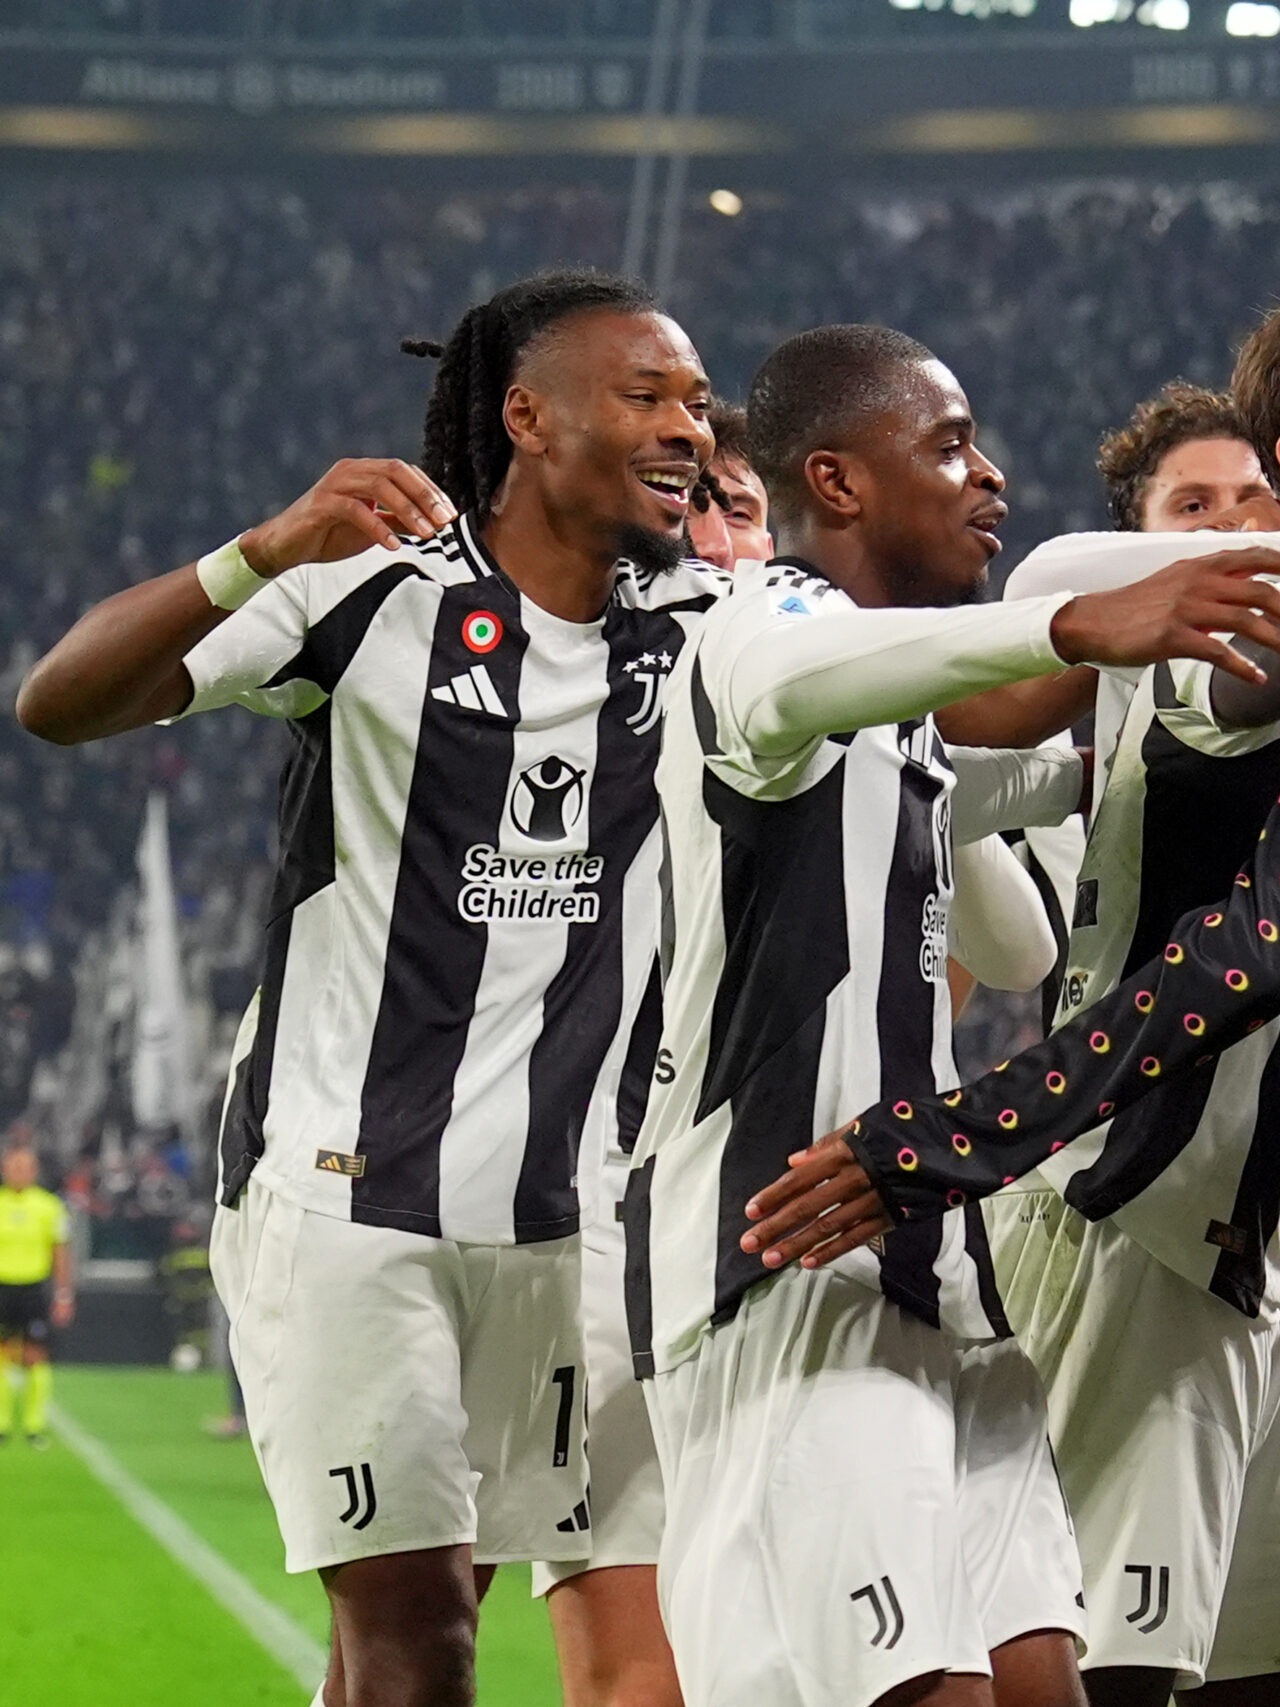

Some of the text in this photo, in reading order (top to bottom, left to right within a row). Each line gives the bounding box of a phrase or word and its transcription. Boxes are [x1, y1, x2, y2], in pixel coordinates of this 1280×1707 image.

[467, 848, 600, 880] Save the
[463, 887, 596, 918] Children
